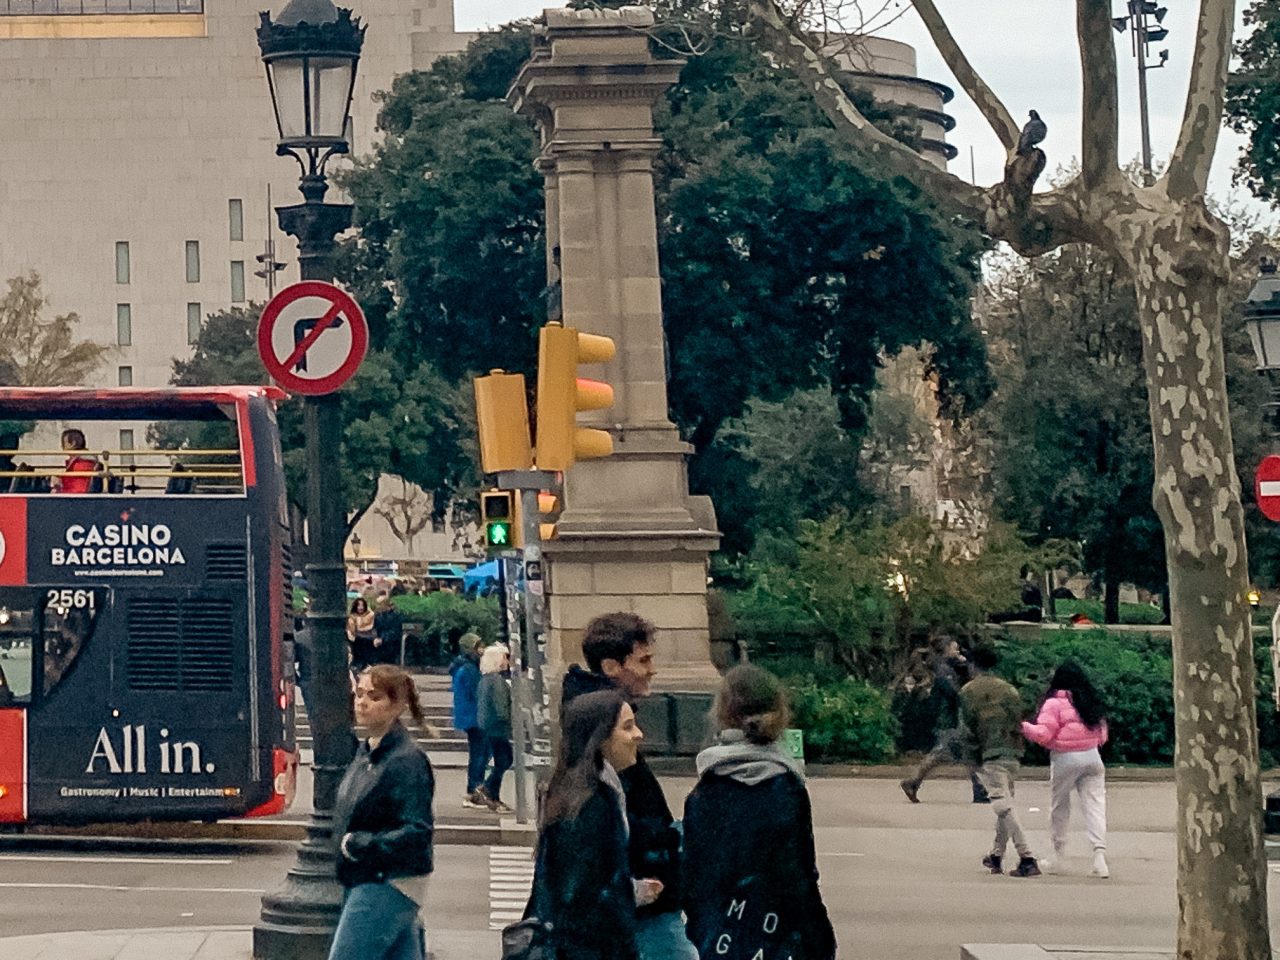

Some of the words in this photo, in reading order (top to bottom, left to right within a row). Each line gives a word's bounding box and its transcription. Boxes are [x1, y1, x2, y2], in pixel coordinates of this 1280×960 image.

[66, 524, 171, 546] CASINO
[51, 547, 186, 565] BARCELONA
[47, 589, 95, 609] 2561
[85, 724, 147, 773] All
[159, 727, 216, 774] in.
[60, 786, 120, 797] Gastronomy
[129, 787, 159, 797] Music
